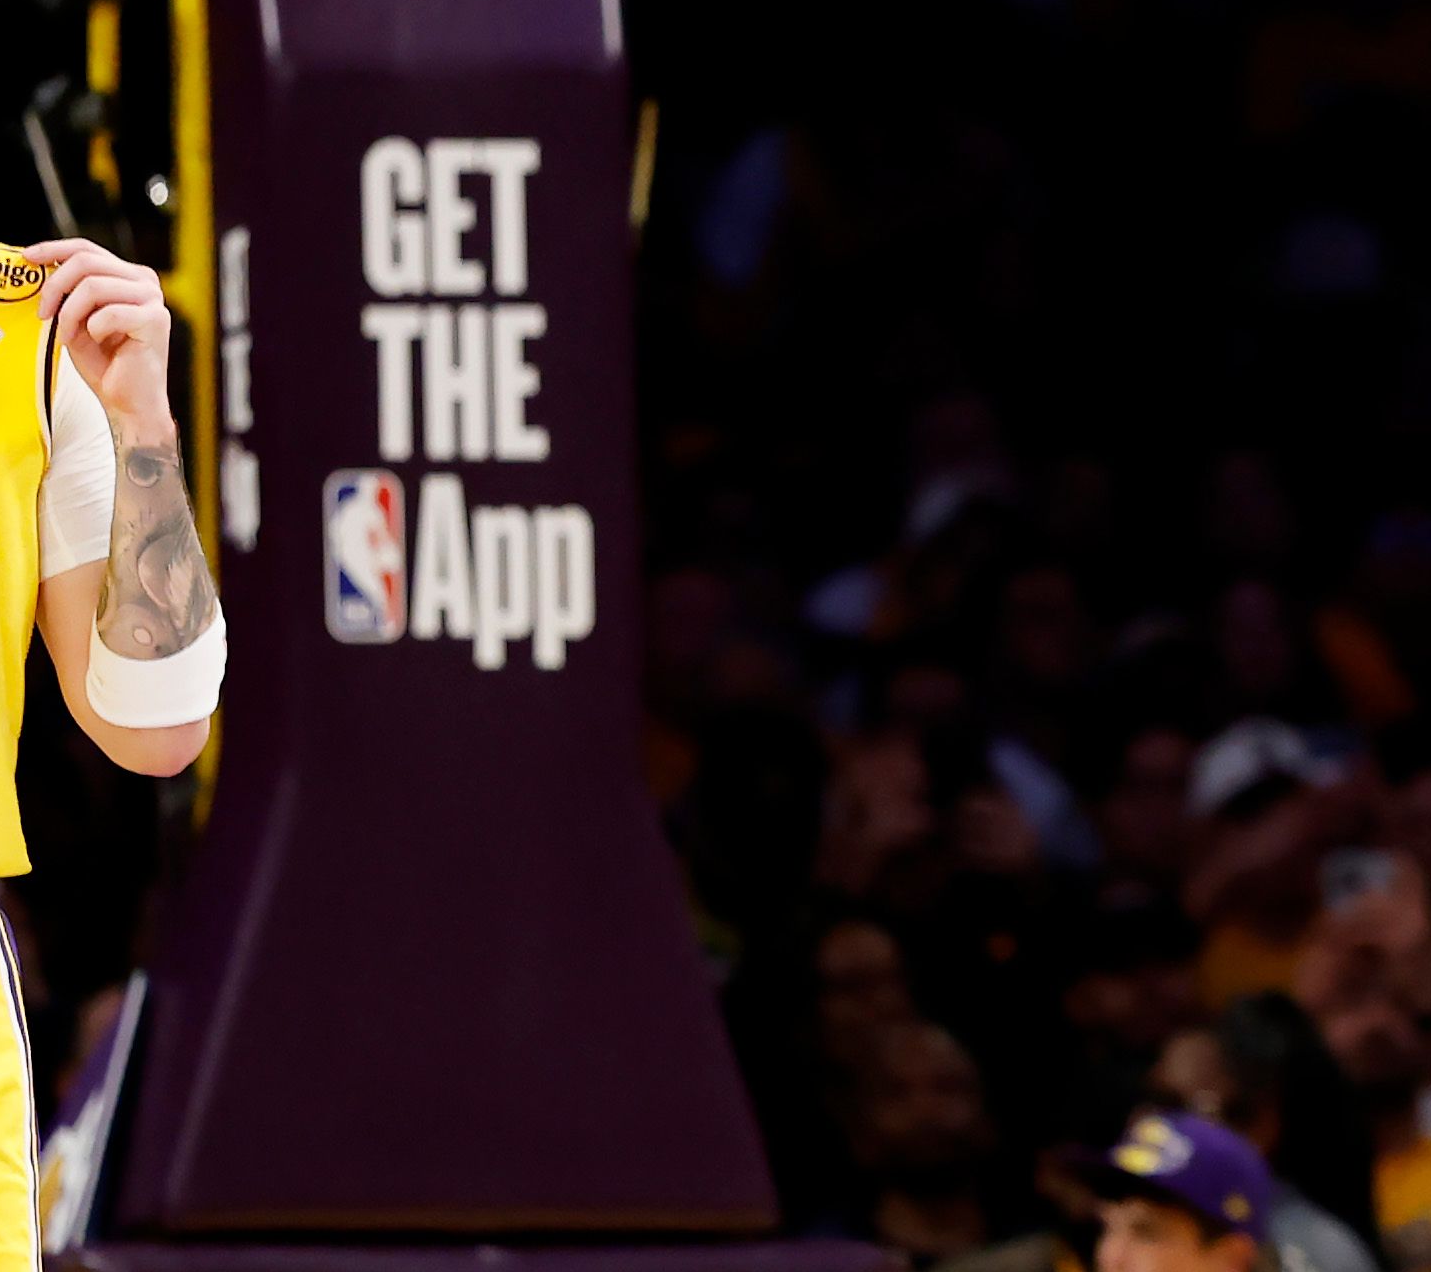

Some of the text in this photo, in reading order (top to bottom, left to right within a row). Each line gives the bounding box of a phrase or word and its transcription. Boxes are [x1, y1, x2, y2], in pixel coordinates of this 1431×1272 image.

[360, 135, 541, 297] GET
[360, 302, 551, 462] THE
[409, 472, 596, 671] App
